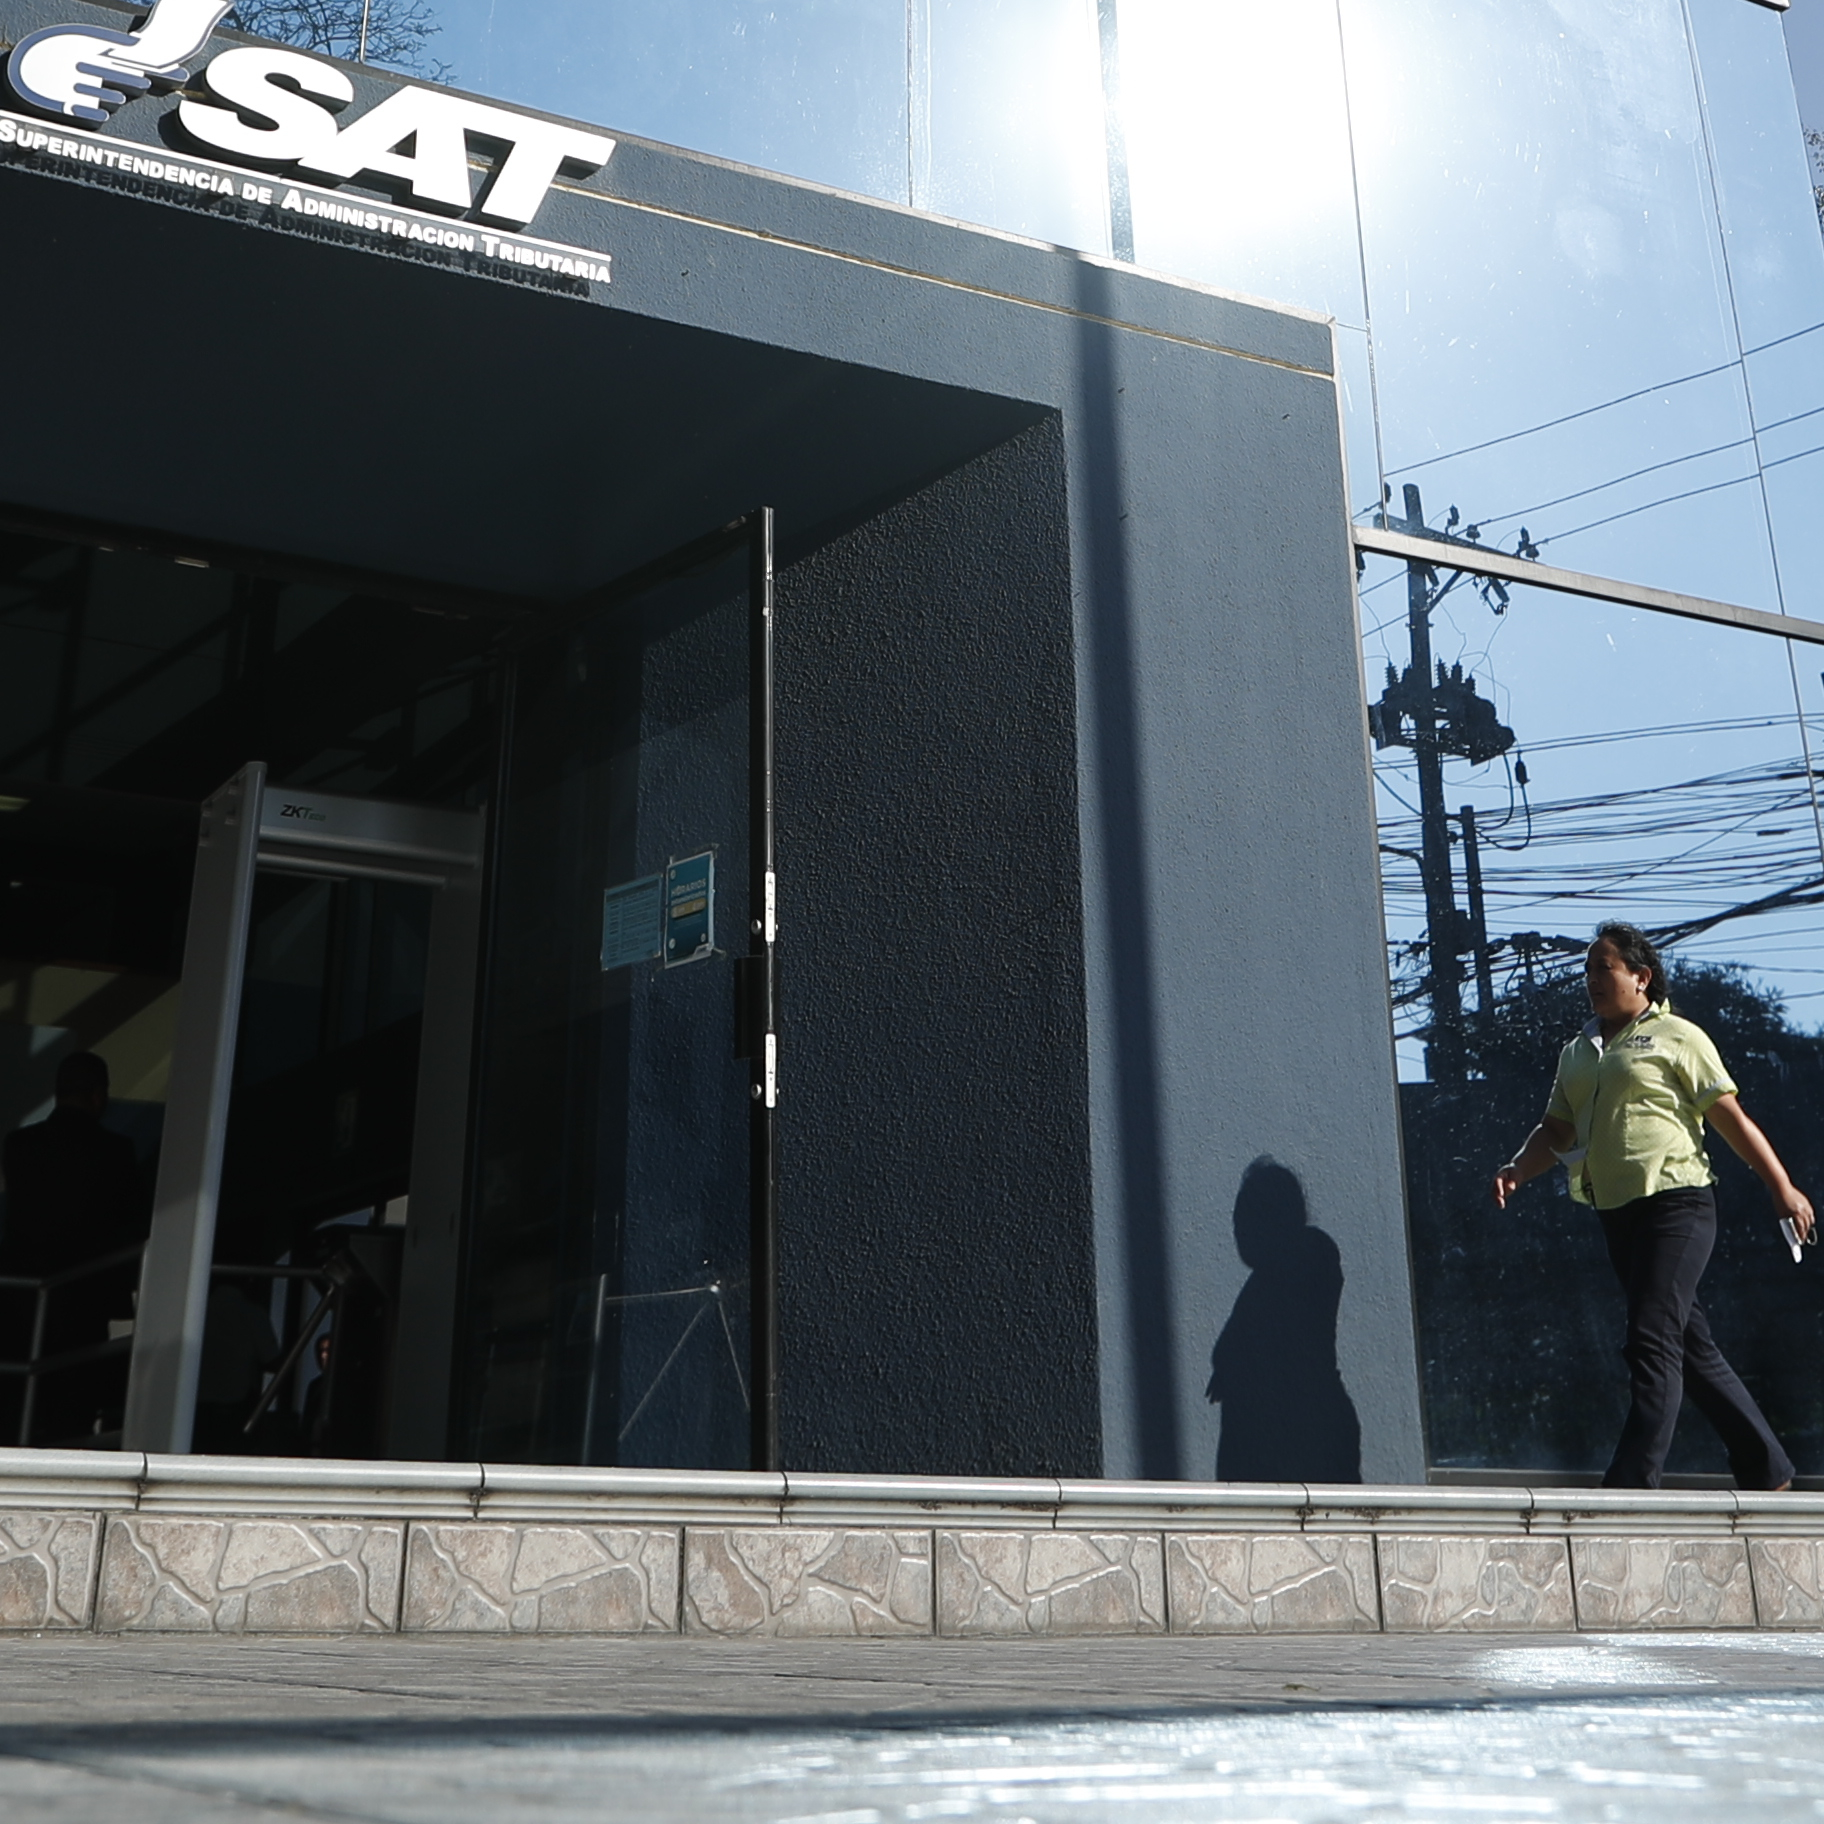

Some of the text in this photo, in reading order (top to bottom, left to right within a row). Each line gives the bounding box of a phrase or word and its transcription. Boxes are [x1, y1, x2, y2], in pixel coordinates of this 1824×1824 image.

[178, 46, 617, 225] SAT
[242, 183, 273, 205] DE
[281, 188, 475, 253] ADMINISTRACION
[480, 234, 611, 283] TRIBUTARIA
